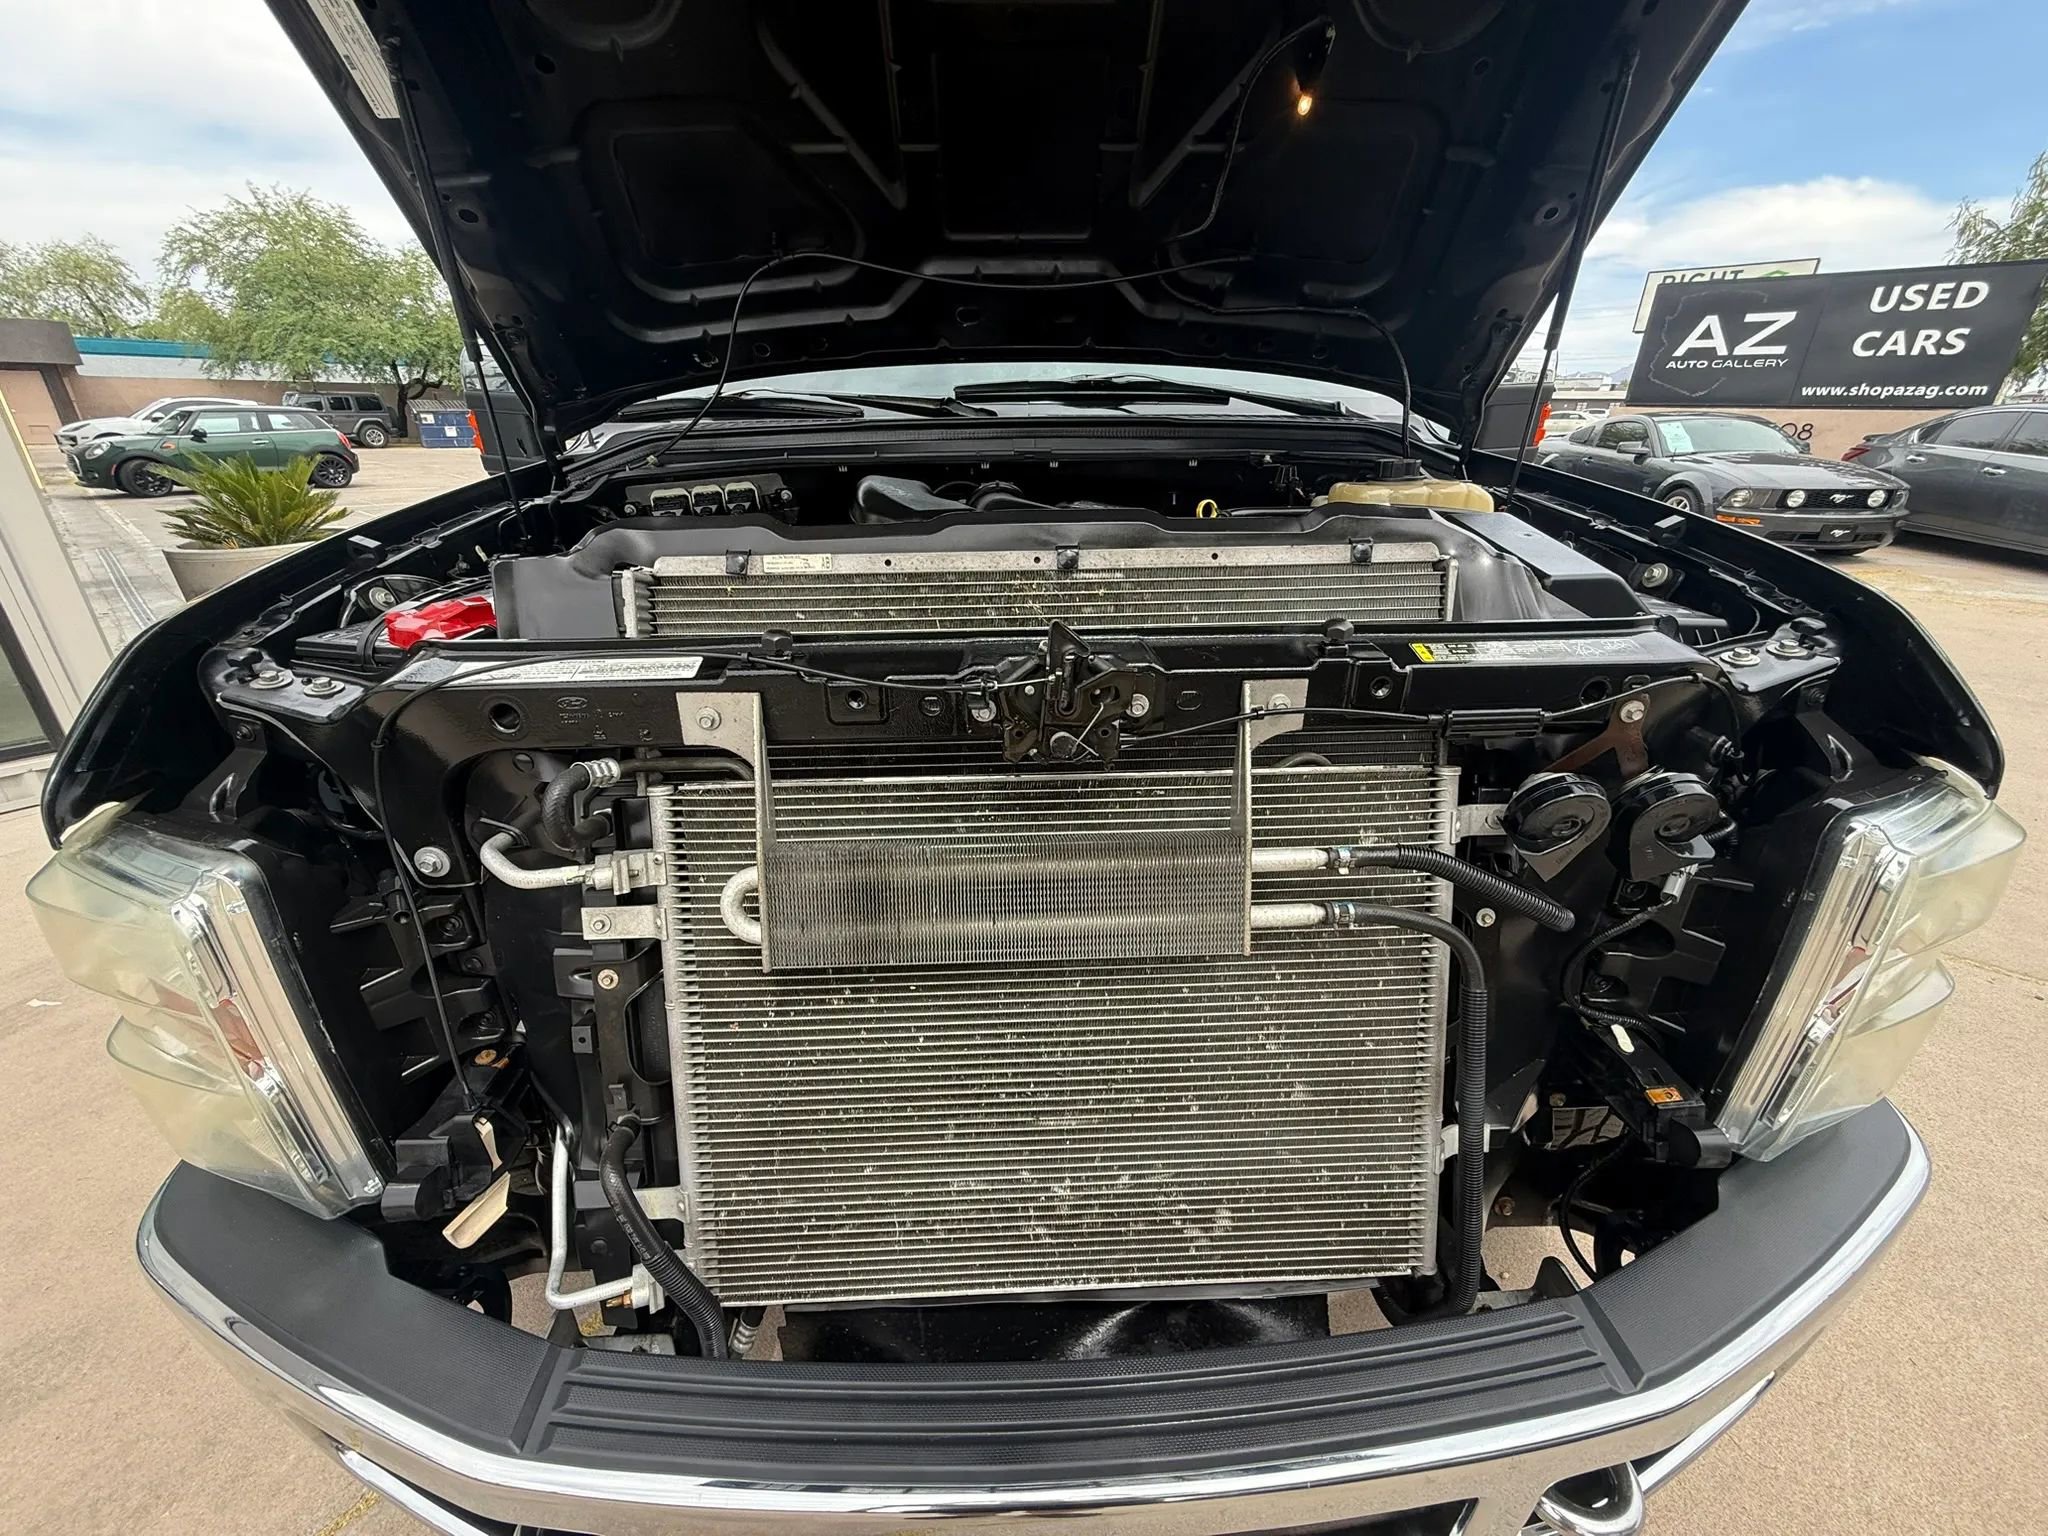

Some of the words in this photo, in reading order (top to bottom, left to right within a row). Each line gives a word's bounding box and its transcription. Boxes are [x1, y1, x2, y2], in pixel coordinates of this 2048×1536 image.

[1869, 281, 1990, 313] USED
[1672, 311, 1798, 357] AZ
[1852, 328, 1971, 357] CARS
[1665, 360, 1709, 369] AUTO
[1711, 358, 1789, 368] GALLERY
[1801, 383, 1989, 399] www.shopazag.com
